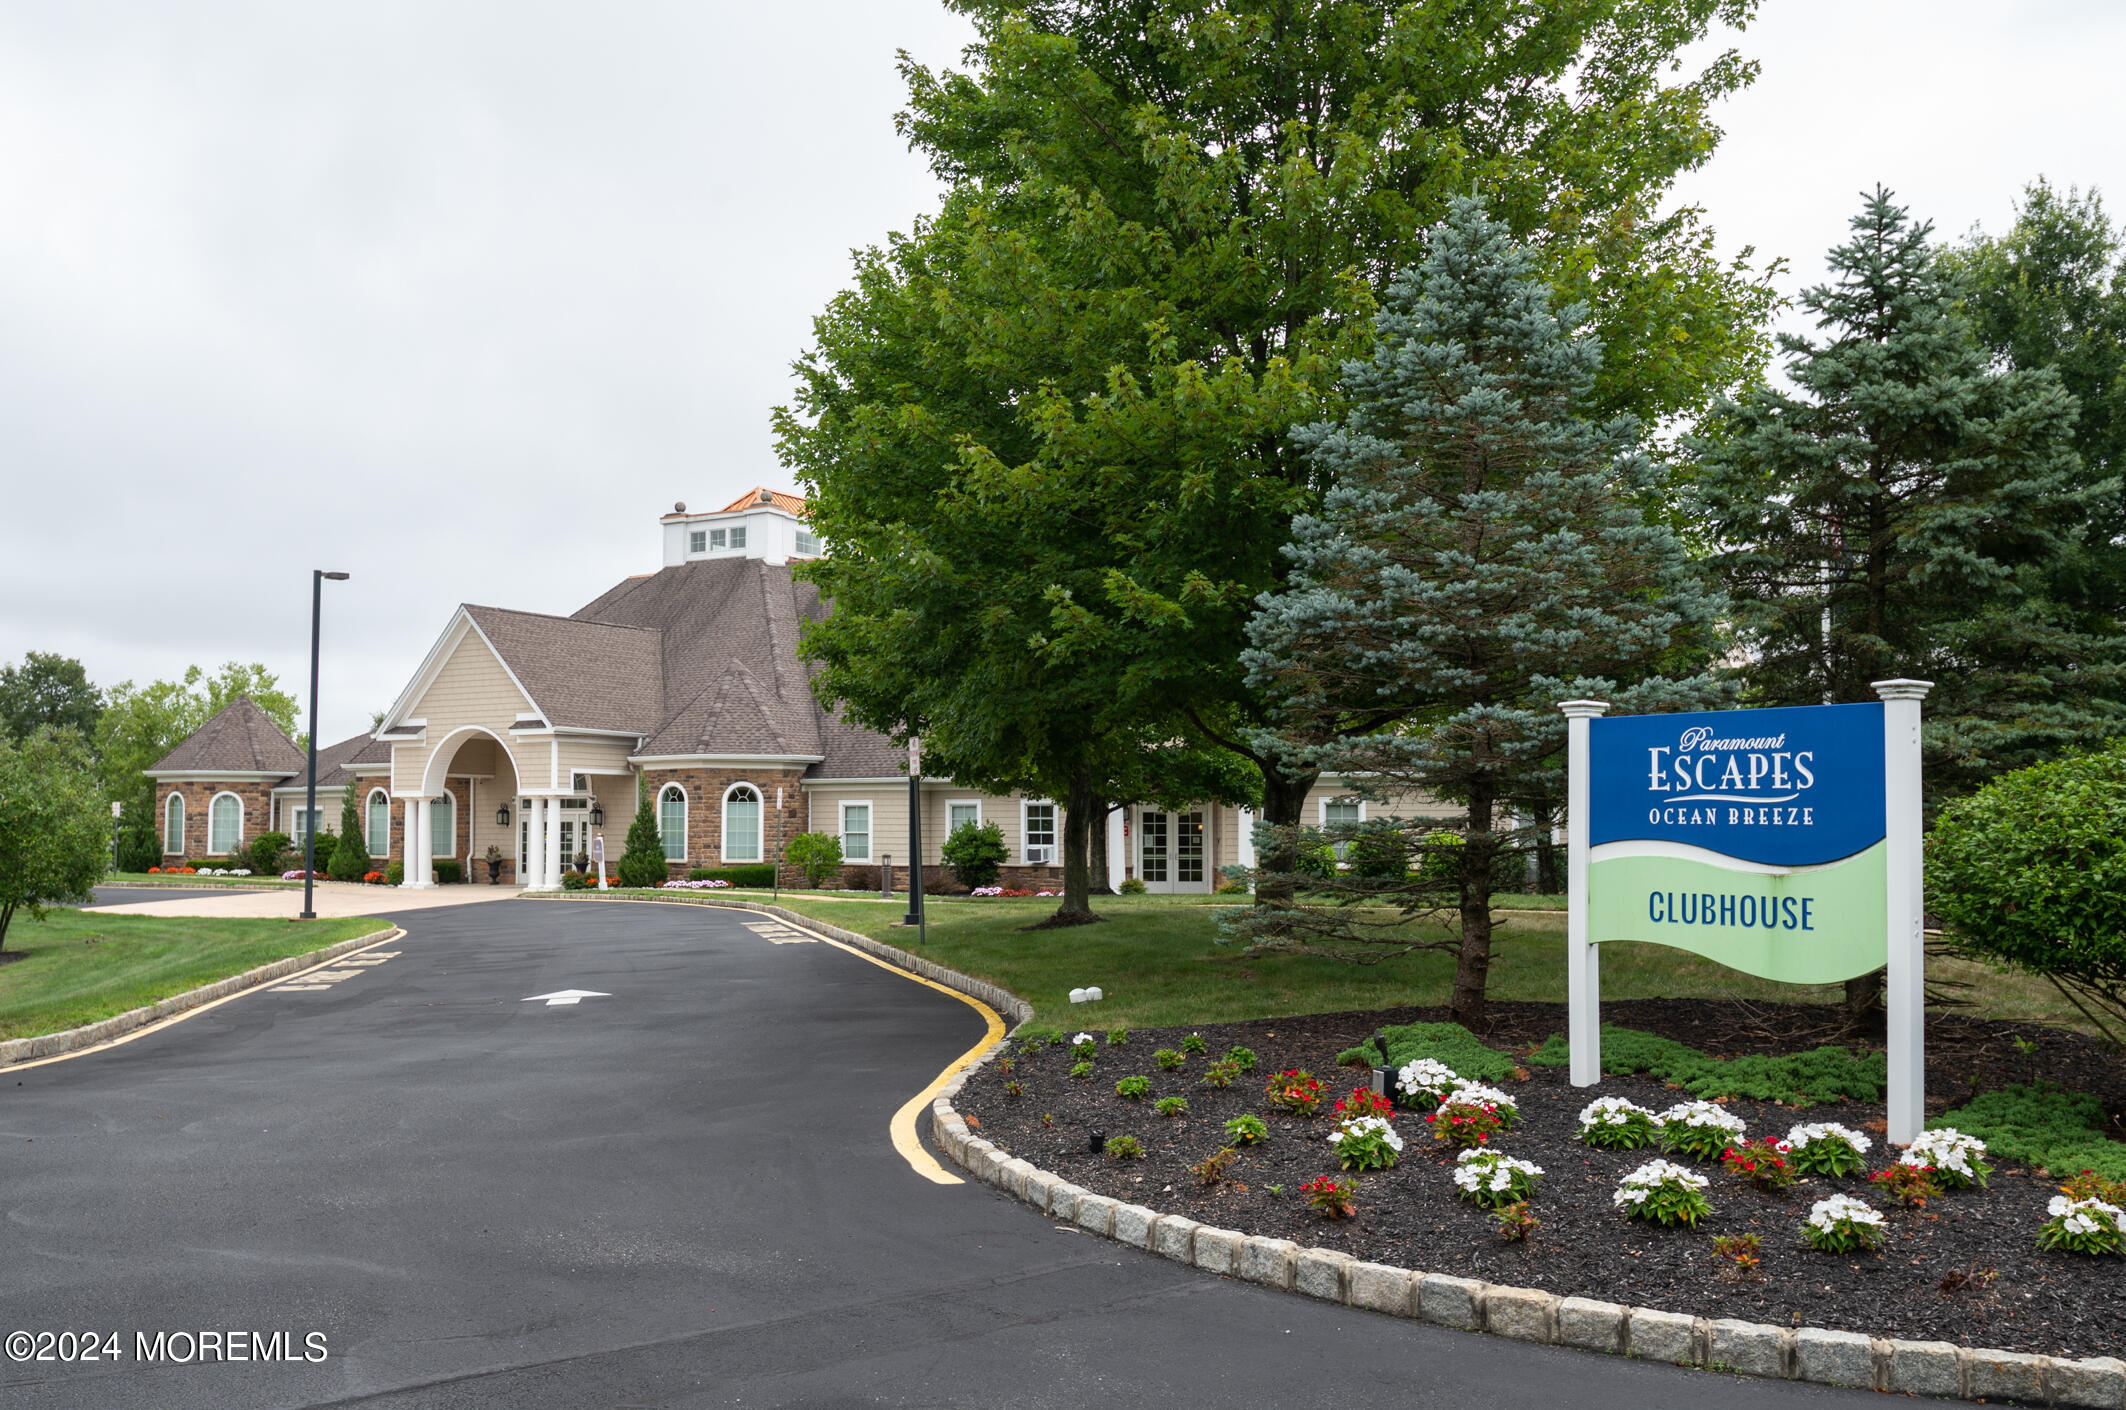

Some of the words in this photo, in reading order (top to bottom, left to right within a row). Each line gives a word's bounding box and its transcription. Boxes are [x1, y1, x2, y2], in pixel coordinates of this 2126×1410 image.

[1679, 726, 1786, 753] Paramount
[1647, 746, 1815, 792] ESCAPES
[1649, 807, 1717, 826] OCEAN
[1728, 807, 1814, 826] BREEZE
[1649, 890, 1815, 931] CLUBHOUSE
